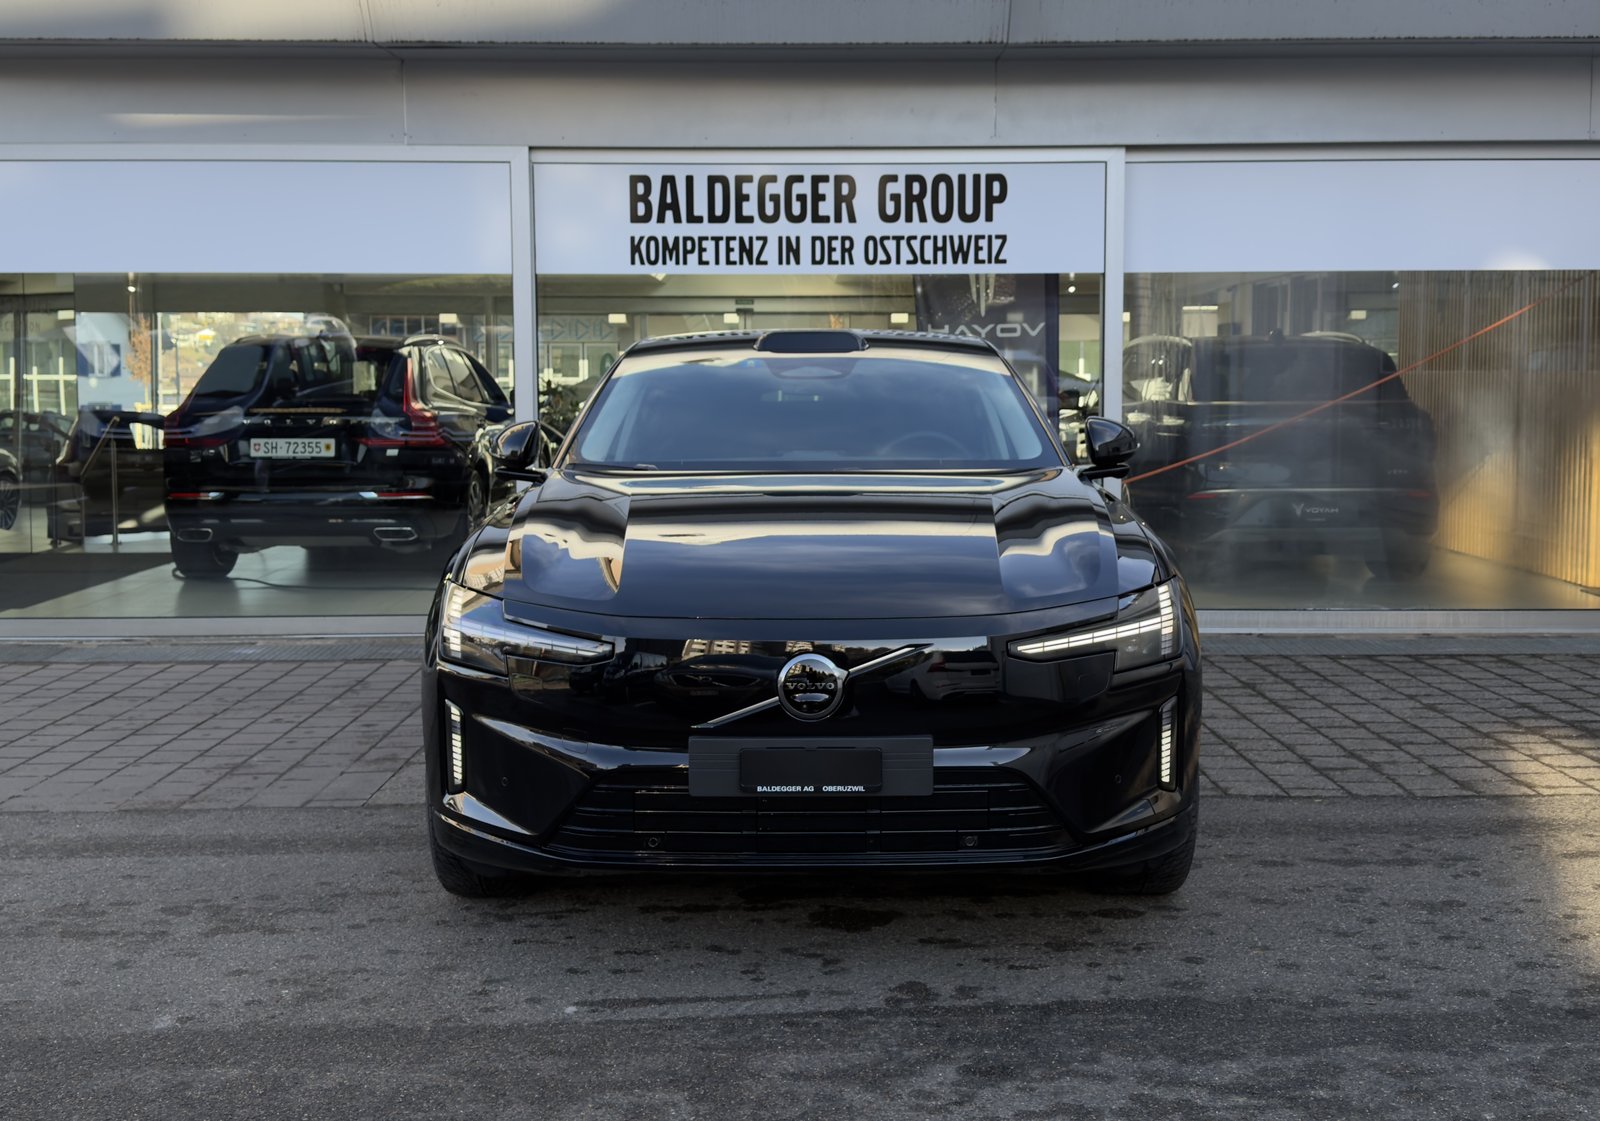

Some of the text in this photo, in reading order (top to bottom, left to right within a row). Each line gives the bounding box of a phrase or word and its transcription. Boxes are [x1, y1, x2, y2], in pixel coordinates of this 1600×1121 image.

[629, 173, 1008, 224] BALDEGGER GROUP
[630, 234, 1008, 266] KOMPETENZ IN DER OSTSCHWEIZ
[786, 682, 835, 690] VOLVO
